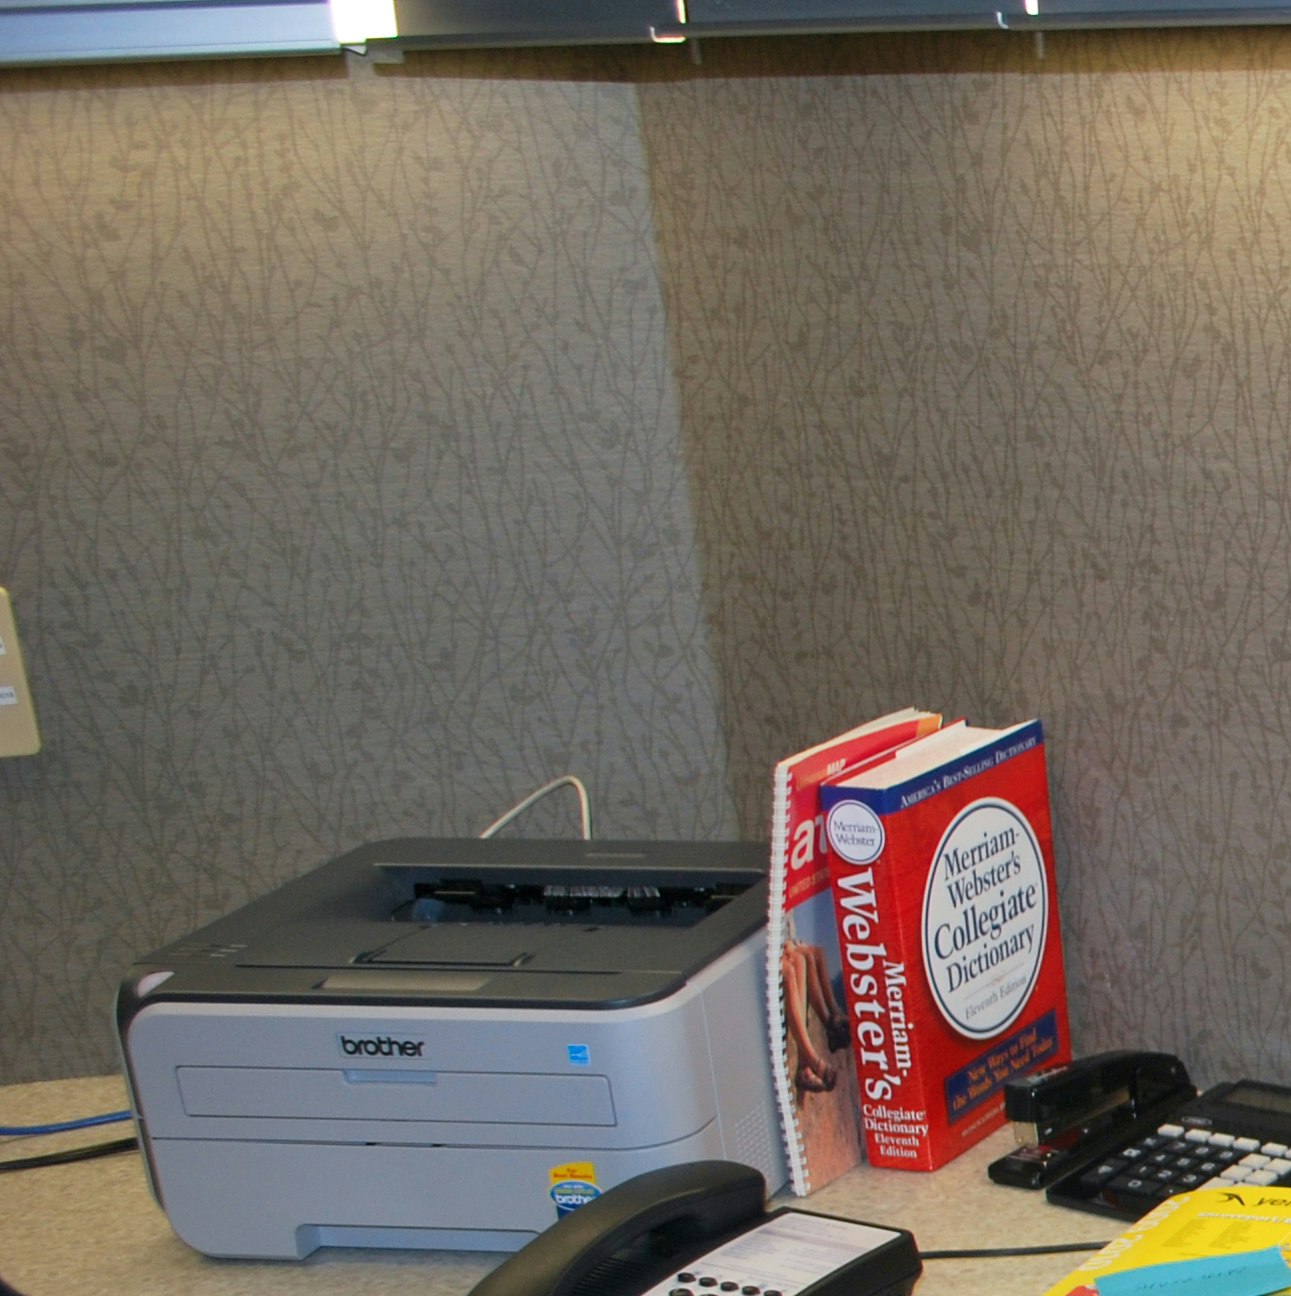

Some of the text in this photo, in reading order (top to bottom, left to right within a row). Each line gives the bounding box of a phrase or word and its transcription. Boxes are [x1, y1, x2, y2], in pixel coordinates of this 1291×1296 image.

[900, 778, 942, 809] AMERICA'S
[995, 737, 1037, 764] DICTIONARY
[834, 820, 877, 833] Merriam-
[836, 834, 875, 848] Webster
[944, 826, 1020, 881] Merriam-
[947, 851, 1021, 909] Webster's
[934, 883, 1037, 960] Collegiate
[946, 924, 1035, 993] Dictionary
[837, 867, 901, 1101] Webster's
[965, 974, 1027, 1021] Eleventh Edition
[882, 960, 914, 1077] Merriam-
[340, 1034, 424, 1057] brother
[863, 1104, 924, 1122] Collegiate
[865, 1117, 928, 1137] Dictionary
[874, 1132, 920, 1147] Eleventh
[880, 1145, 917, 1159] Edition
